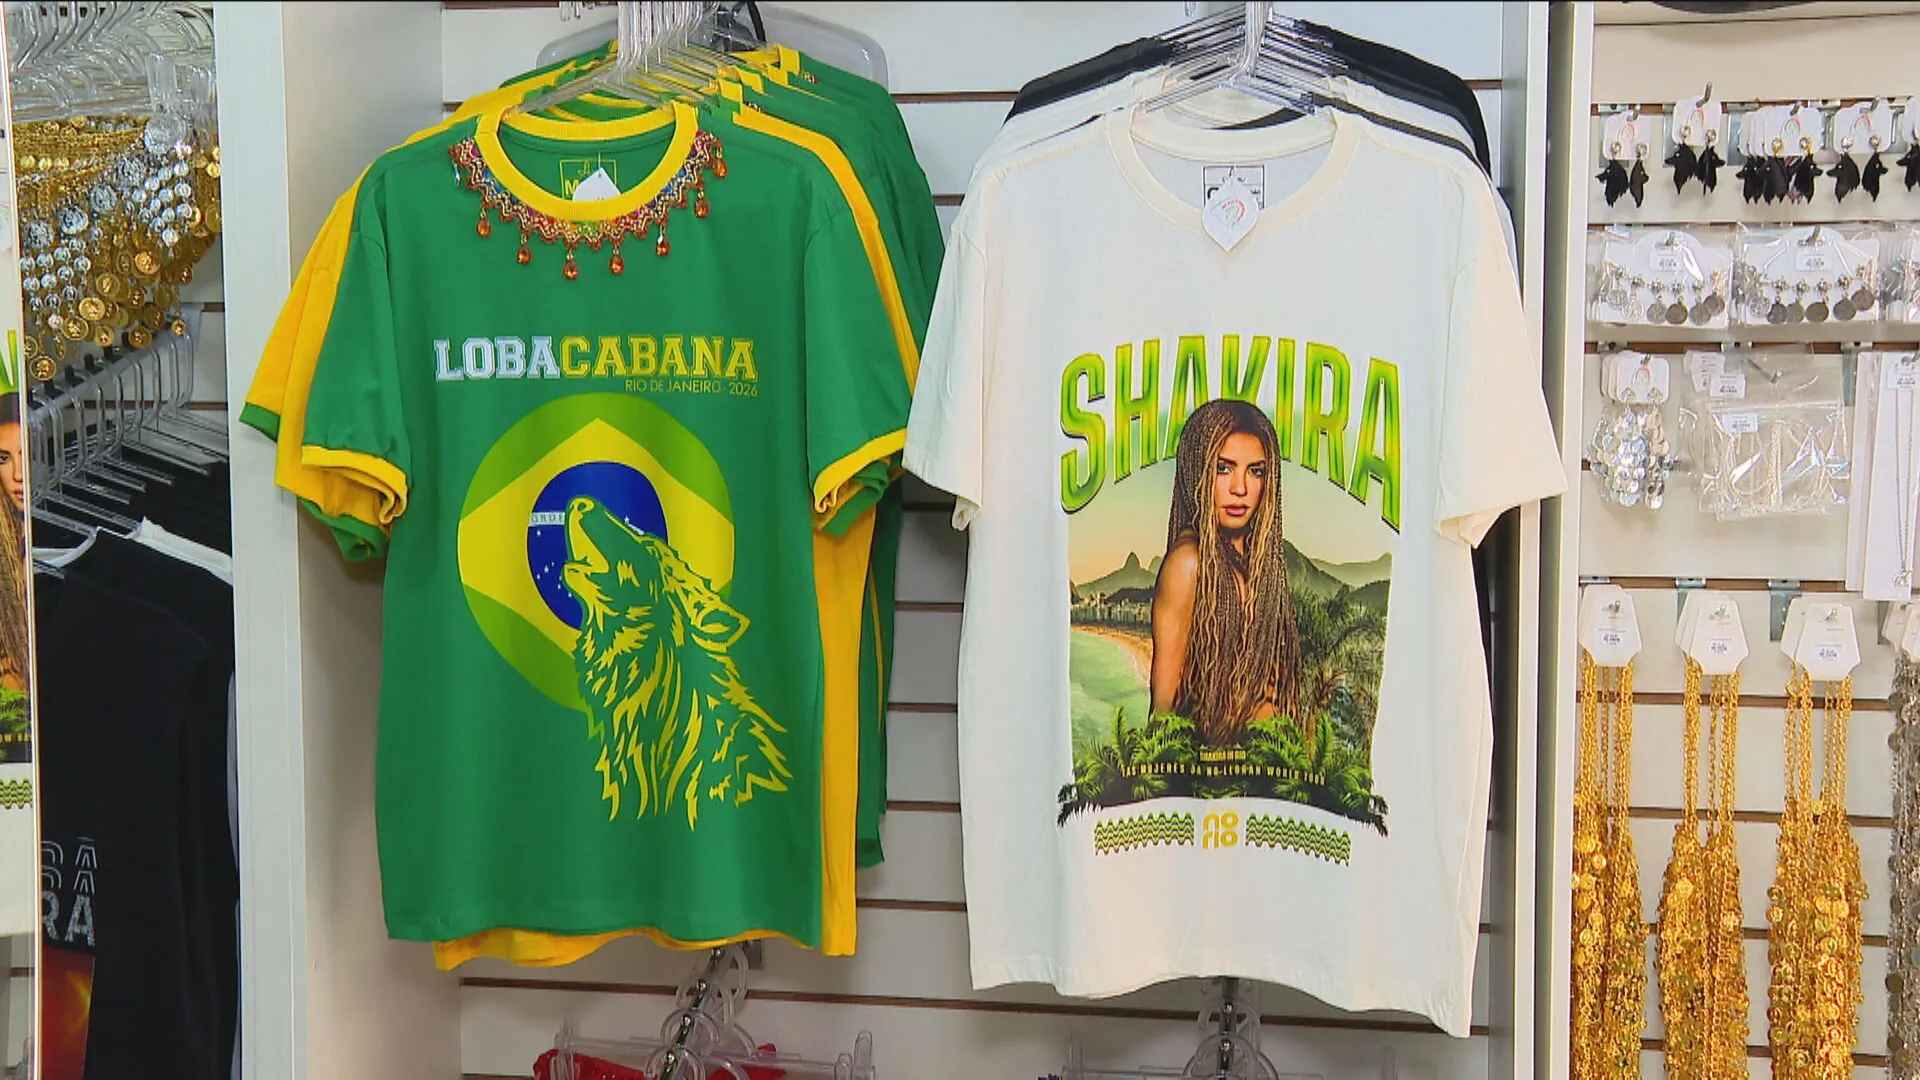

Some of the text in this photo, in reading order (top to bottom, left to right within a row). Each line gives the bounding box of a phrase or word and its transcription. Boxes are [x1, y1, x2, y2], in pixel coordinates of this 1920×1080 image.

[434, 334, 758, 381] LOBACABANA
[625, 379, 647, 391] RIO
[650, 380, 664, 392] DE
[667, 380, 721, 393] JANEIRO
[728, 382, 758, 397] 2026
[1060, 334, 1401, 535] SHAKIRA
[1140, 762, 1185, 775] MUJERES
[1266, 766, 1299, 780] WORLD
